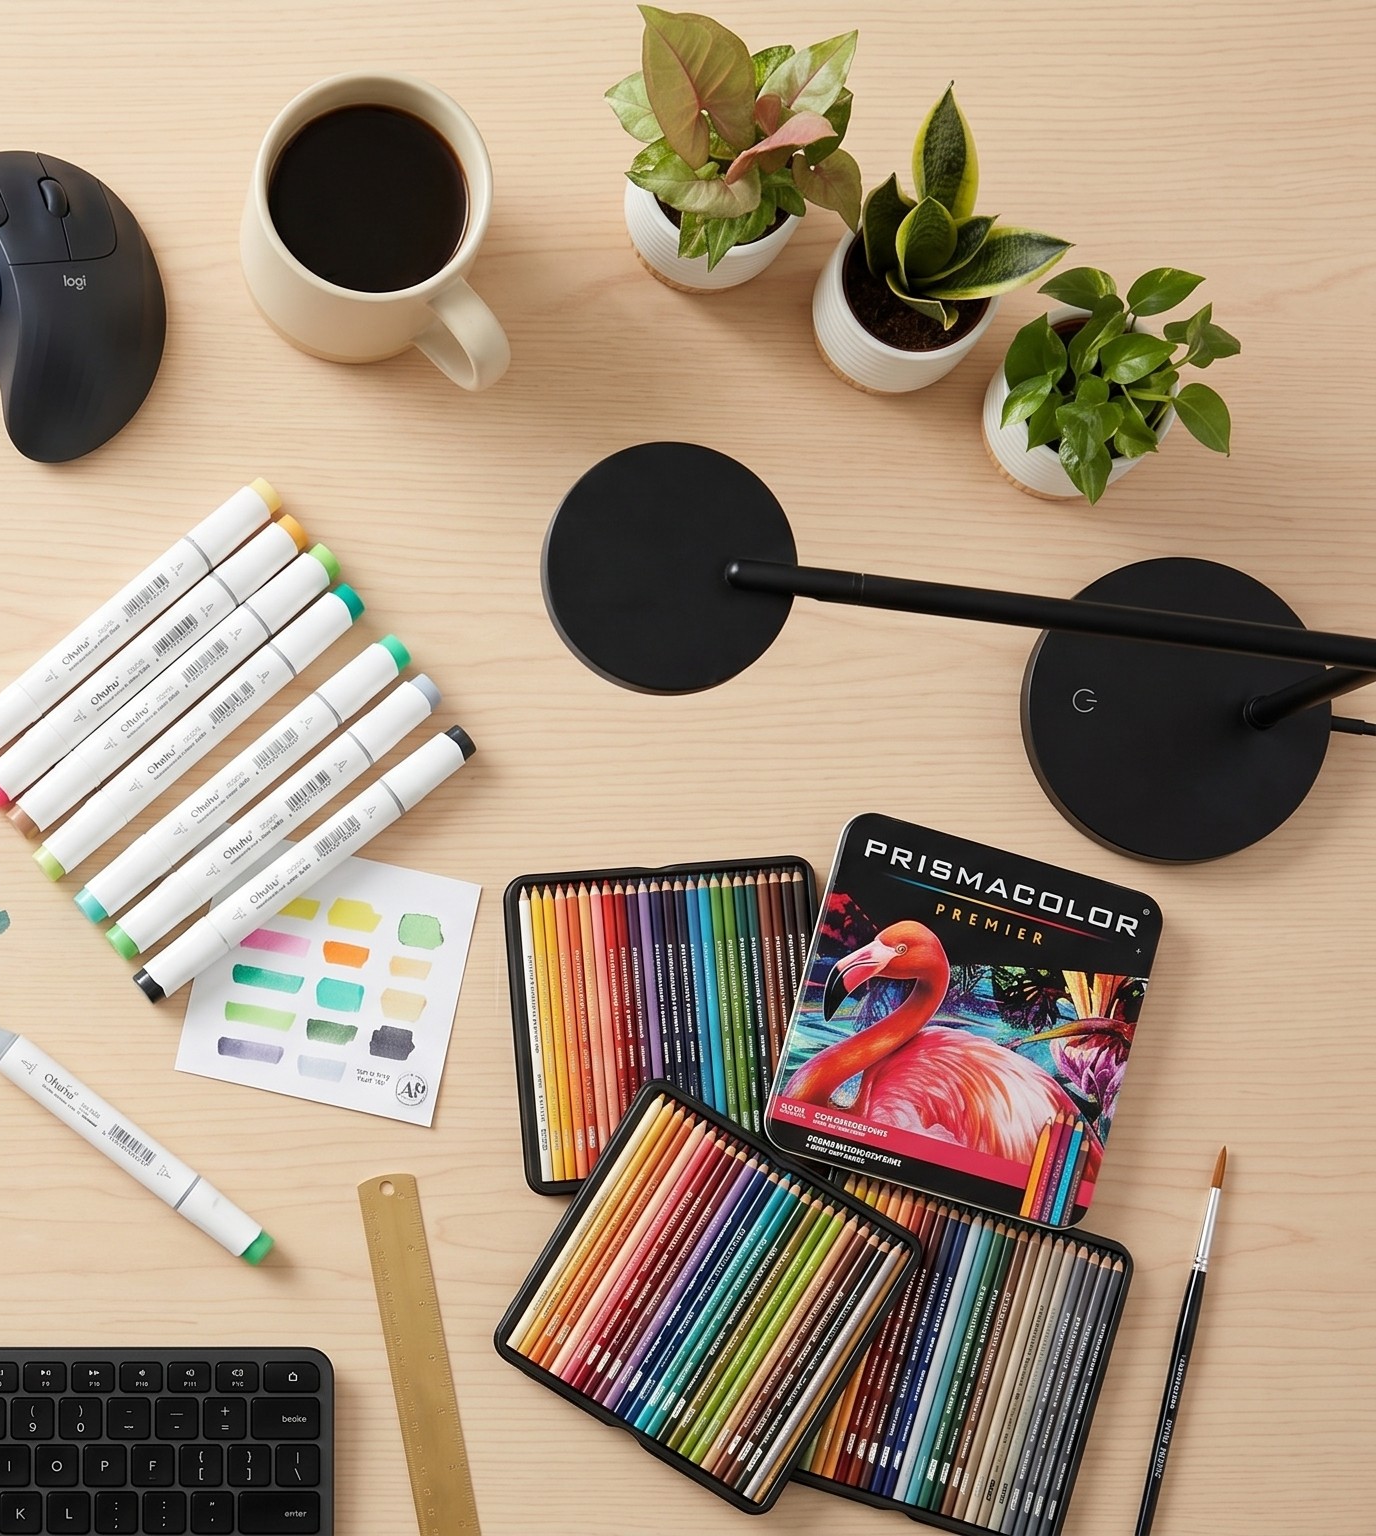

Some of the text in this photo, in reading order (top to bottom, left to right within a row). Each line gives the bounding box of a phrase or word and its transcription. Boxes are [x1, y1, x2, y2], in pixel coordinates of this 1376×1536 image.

[63, 274, 86, 290] logi
[864, 838, 1139, 938] PRISMACOLOR
[935, 903, 1043, 946] PREMIER
[29, 1422, 37, 1433] 9
[51, 1460, 63, 1472] O
[101, 1460, 109, 1472] P
[149, 1460, 157, 1472] F
[16, 1508, 26, 1520] K
[65, 1508, 73, 1520] L
